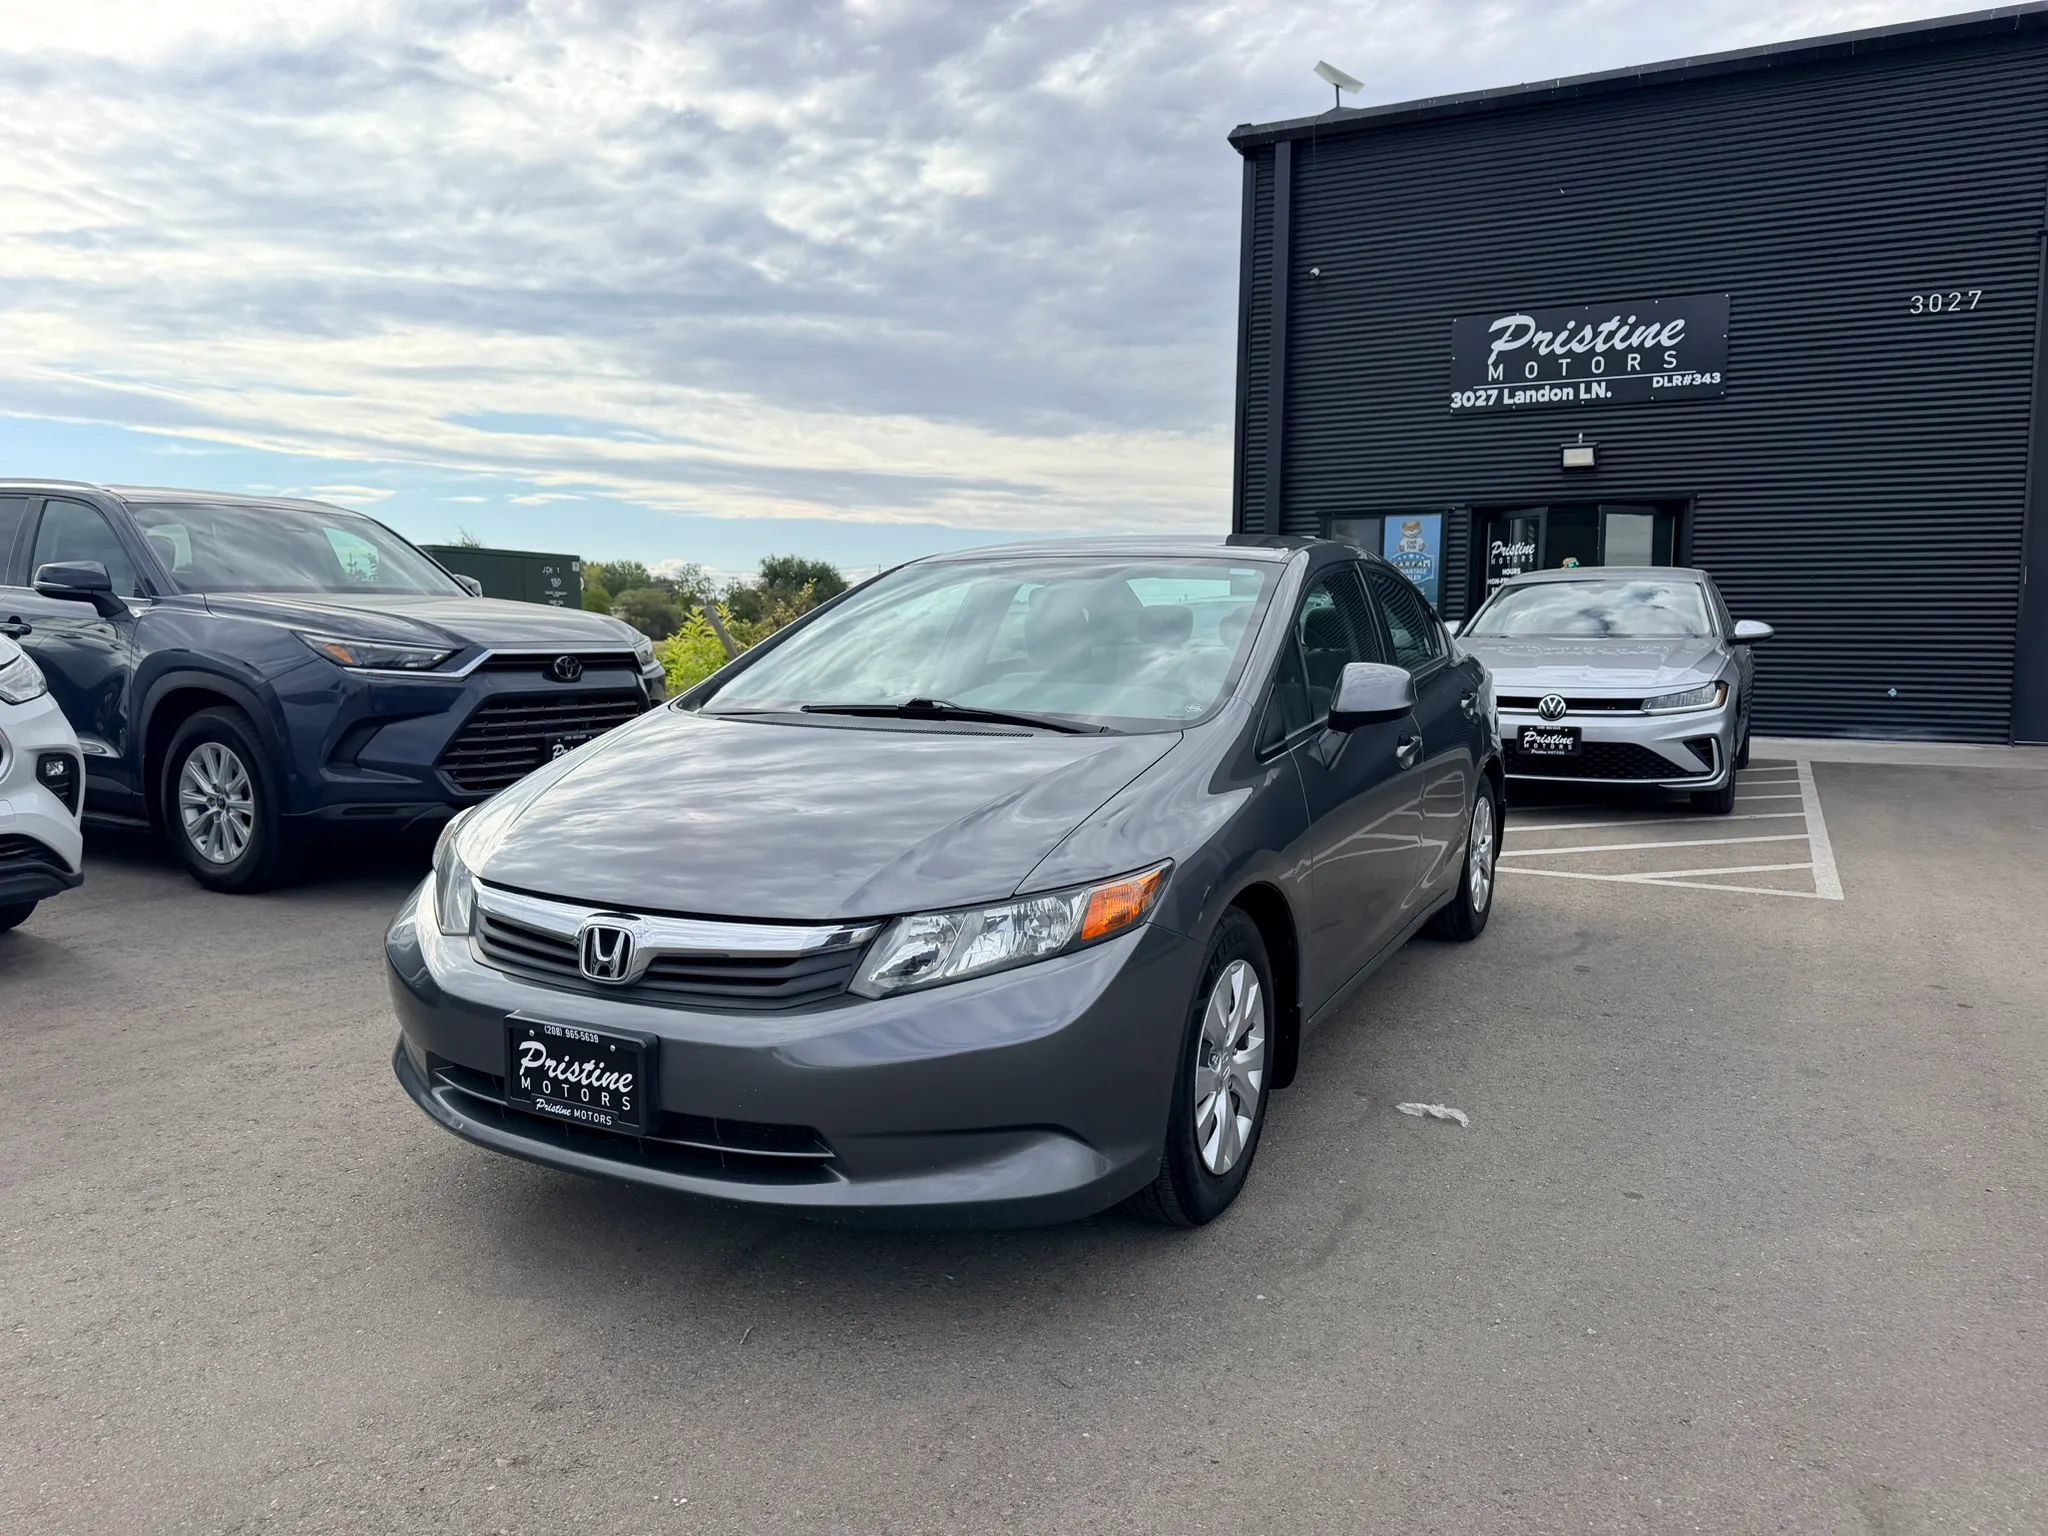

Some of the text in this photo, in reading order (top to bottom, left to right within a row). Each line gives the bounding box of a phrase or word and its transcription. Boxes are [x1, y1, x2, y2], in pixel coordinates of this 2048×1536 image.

[1909, 290, 1982, 314] 3027
[1487, 314, 1686, 366] Pristine
[1487, 350, 1678, 382] MOTORS
[1652, 372, 1721, 389] DLR#343
[1450, 382, 1613, 408] 3027 Landon LN.
[1491, 541, 1536, 559] Pristine
[1523, 731, 1574, 745] Pristine
[544, 1025, 600, 1043] (208) 965-5639
[518, 1040, 634, 1093] Pristine
[521, 1076, 631, 1111] MOTORS
[535, 1098, 613, 1126] Pristine MOTORS
